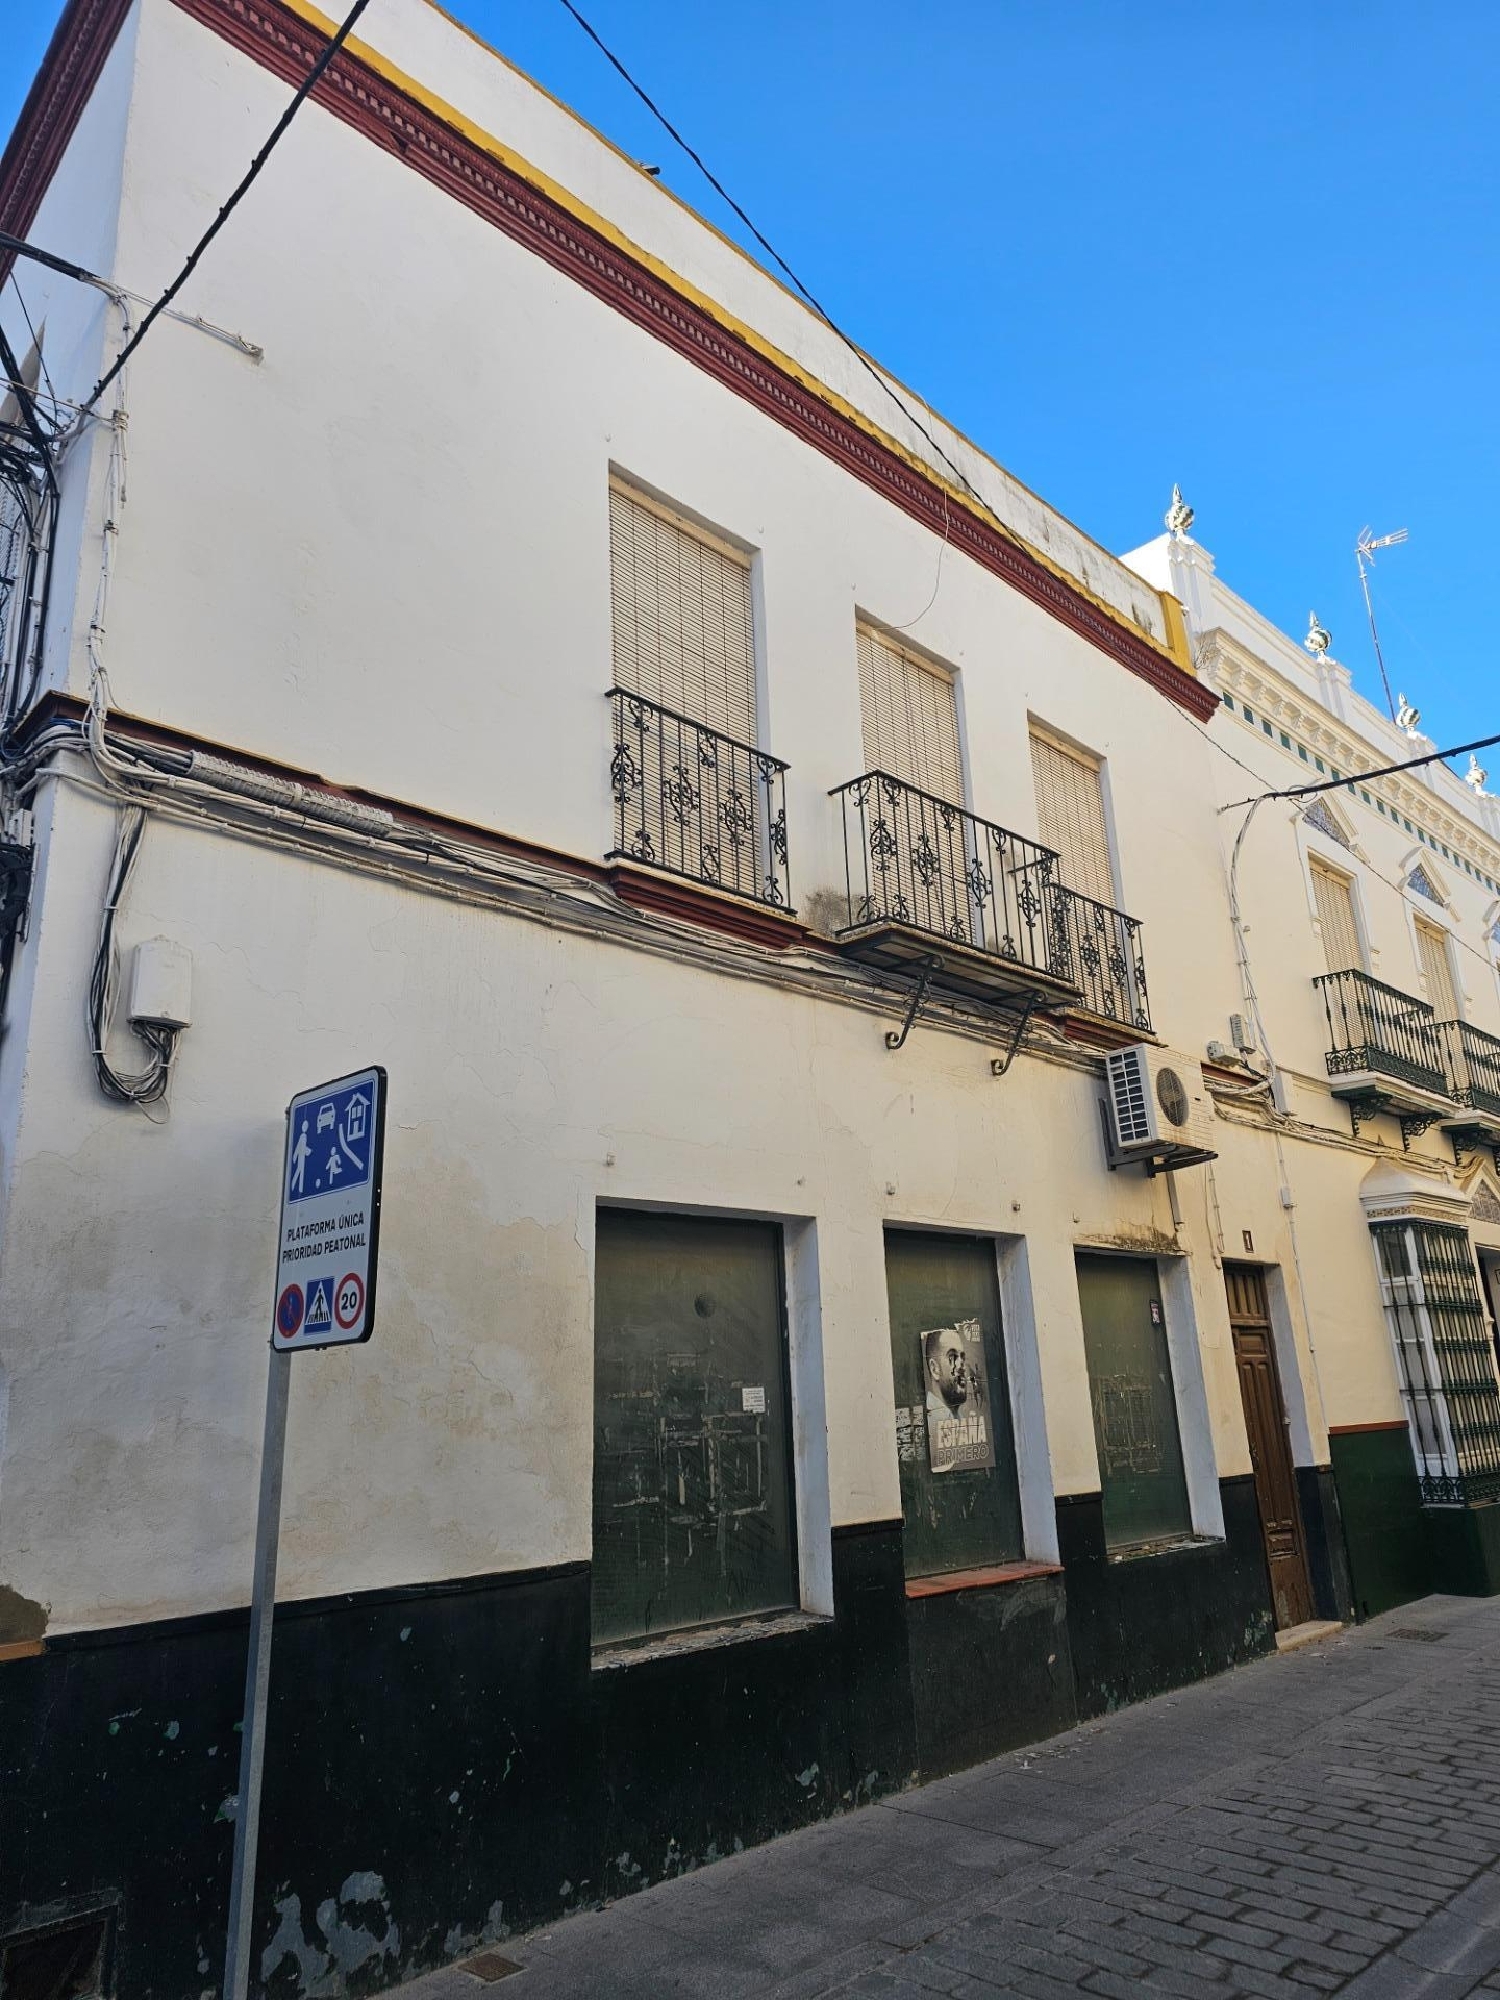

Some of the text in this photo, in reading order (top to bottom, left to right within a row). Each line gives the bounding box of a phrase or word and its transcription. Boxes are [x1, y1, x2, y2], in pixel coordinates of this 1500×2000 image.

[287, 1211, 364, 1242] PLATAFORMA ÚNICA
[282, 1233, 366, 1263] PRIORIDAD PEATONAL
[341, 1291, 357, 1310] 20
[937, 1410, 987, 1449] ESPAÑA
[937, 1445, 990, 1466] PRIMERO
